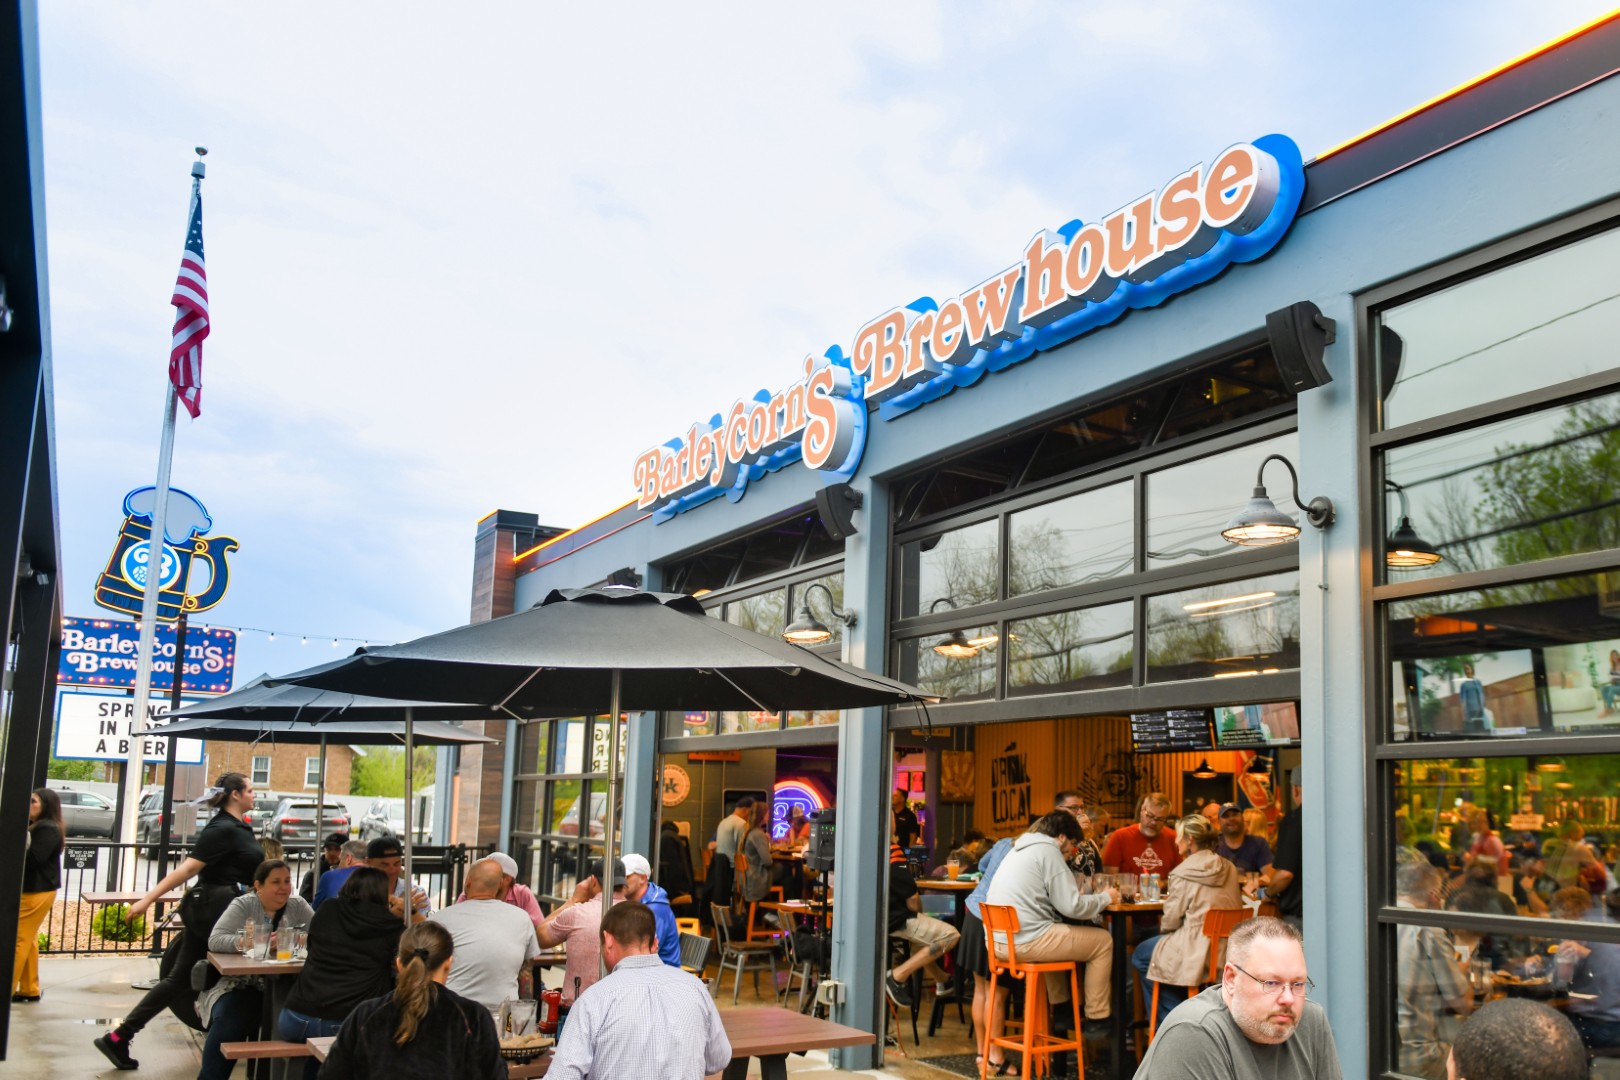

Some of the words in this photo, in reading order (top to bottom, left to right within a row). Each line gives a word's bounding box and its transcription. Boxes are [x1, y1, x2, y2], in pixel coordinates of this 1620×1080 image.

[851, 143, 1259, 400] Brewhouse
[98, 702, 168, 719] SPRNG
[99, 720, 117, 736] IN
[95, 738, 106, 753] A
[118, 739, 166, 755] BER
